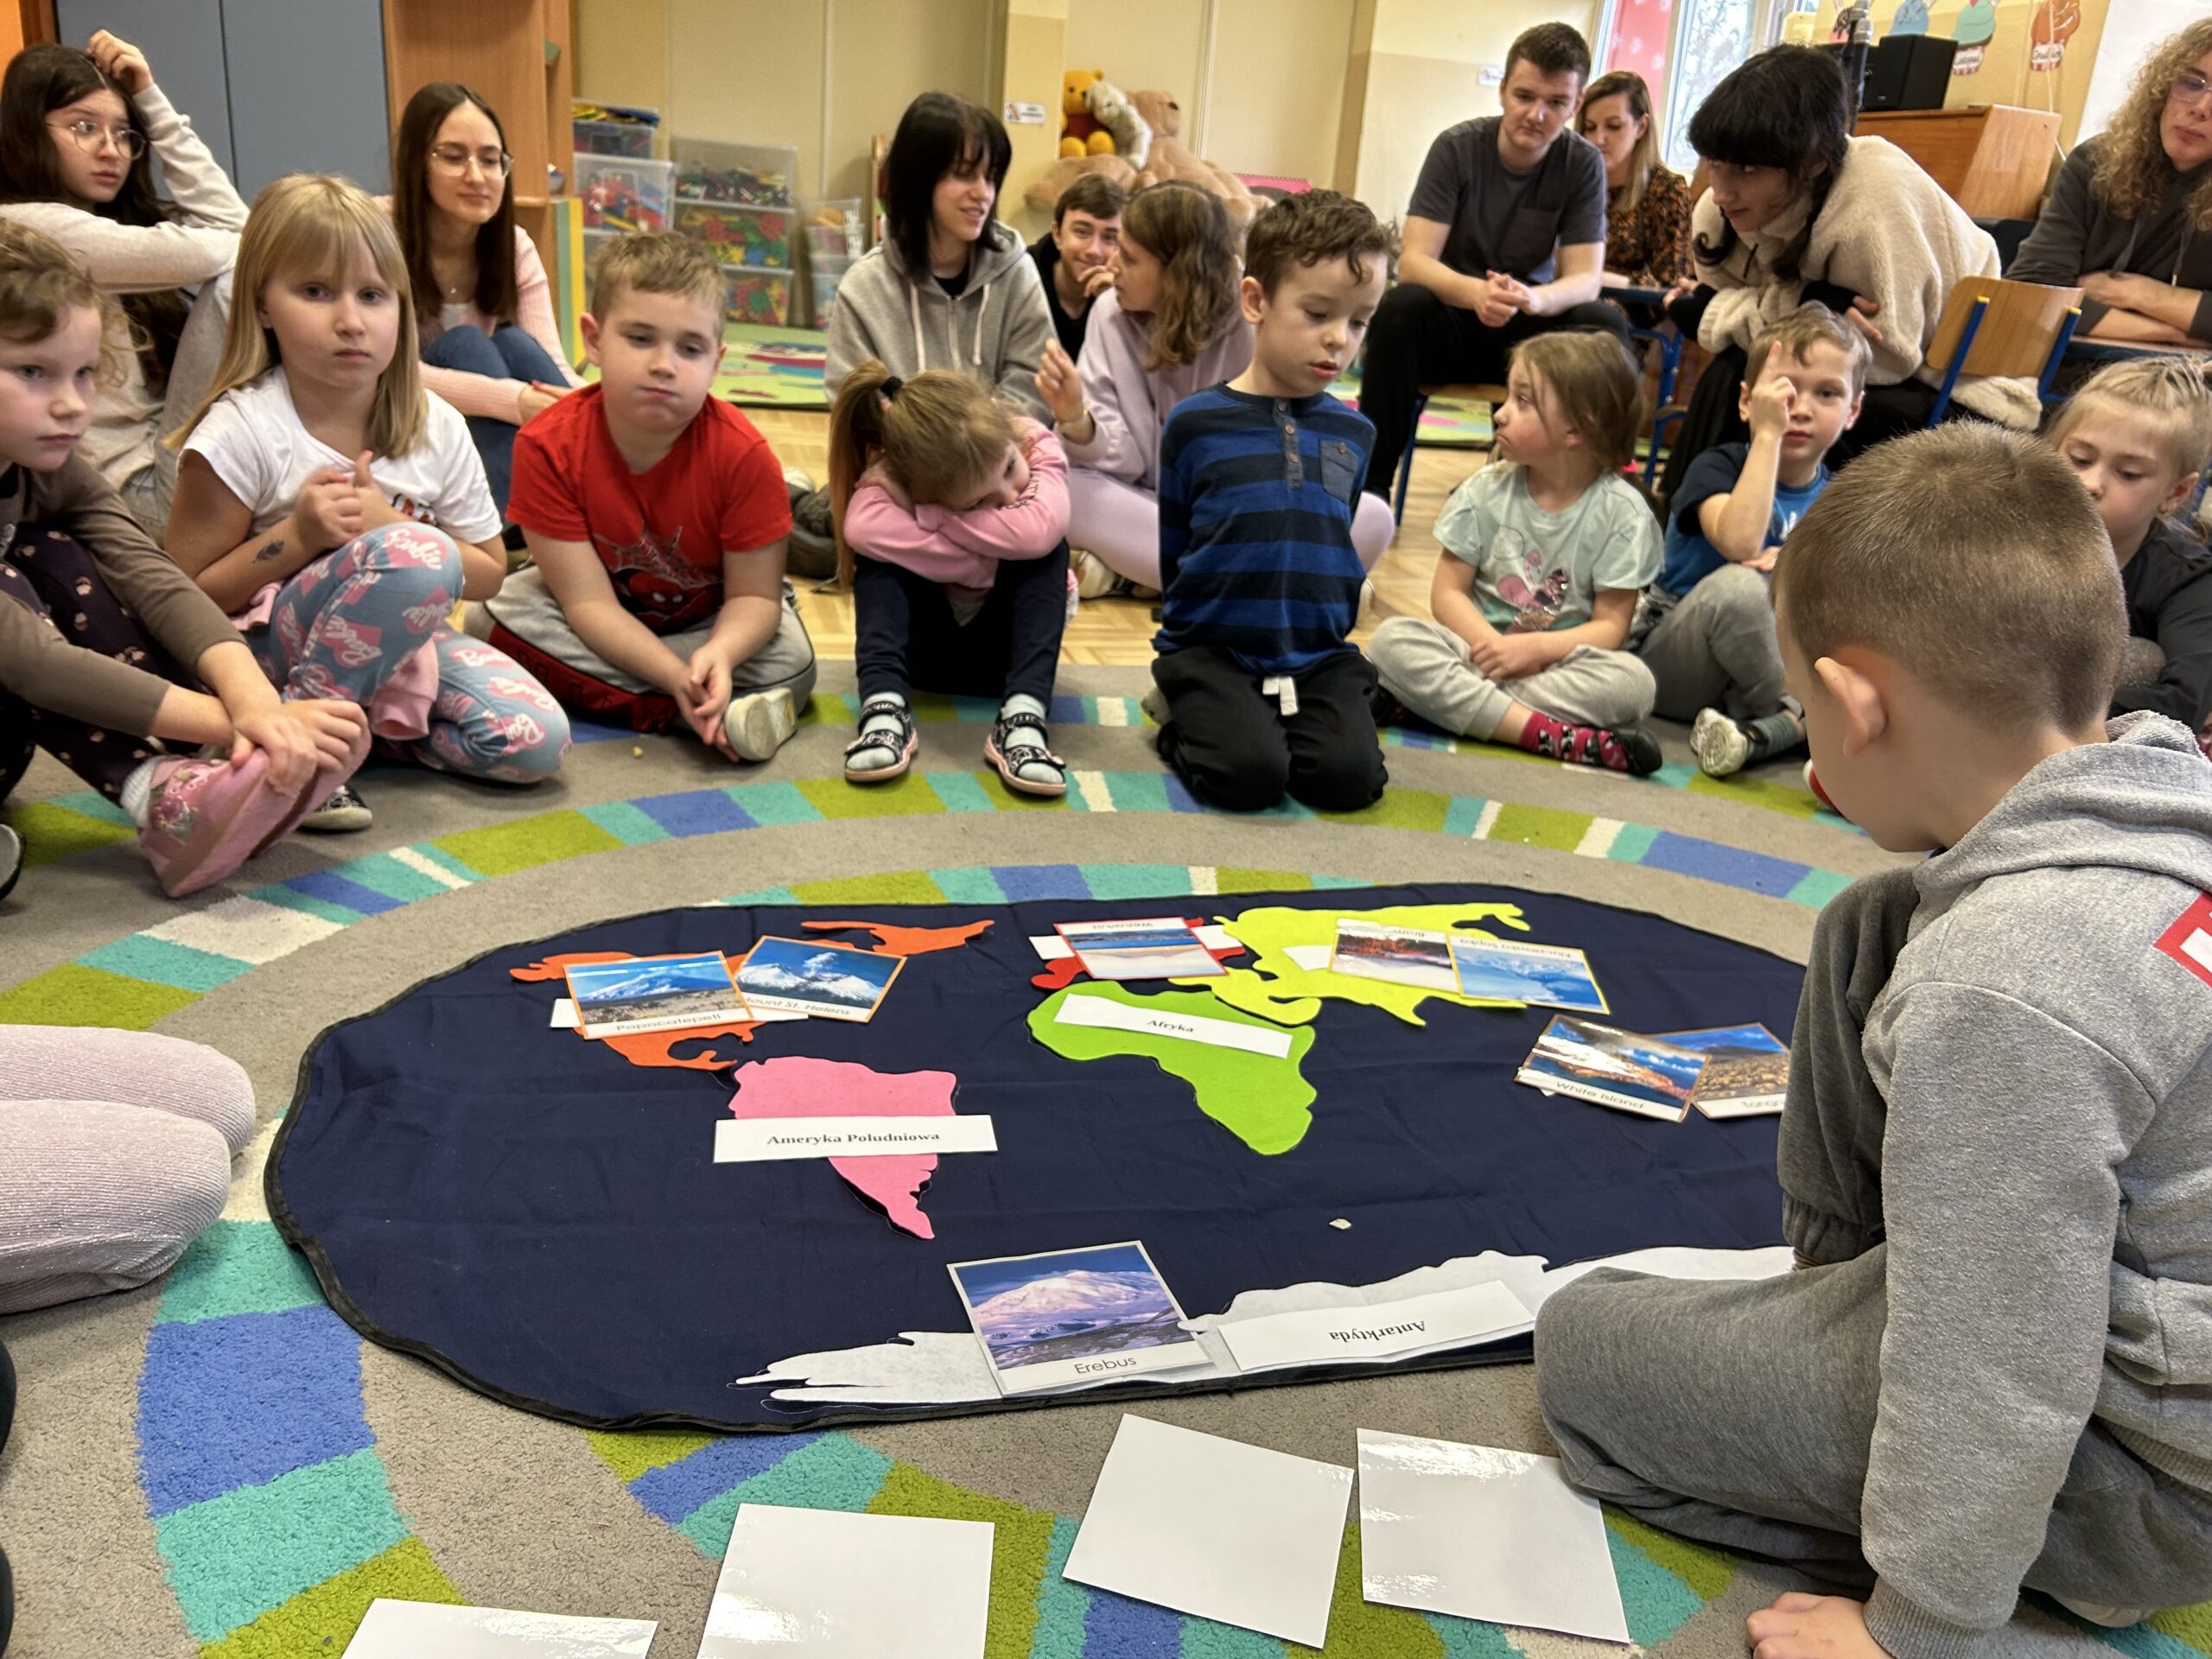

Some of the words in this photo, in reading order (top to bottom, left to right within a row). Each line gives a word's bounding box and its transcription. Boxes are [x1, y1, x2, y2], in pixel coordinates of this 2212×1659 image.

[746, 997, 783, 1007] ount
[804, 1004, 851, 1015] Helens
[616, 1014, 721, 1031] Popocatepetl
[1147, 1020, 1194, 1033] Afryka
[1557, 1082, 1597, 1097] White
[1600, 1093, 1644, 1109] Island
[767, 1135, 842, 1145] Ameryka
[1328, 1320, 1426, 1343] Antarktyda
[1074, 1357, 1137, 1374] Erebus
